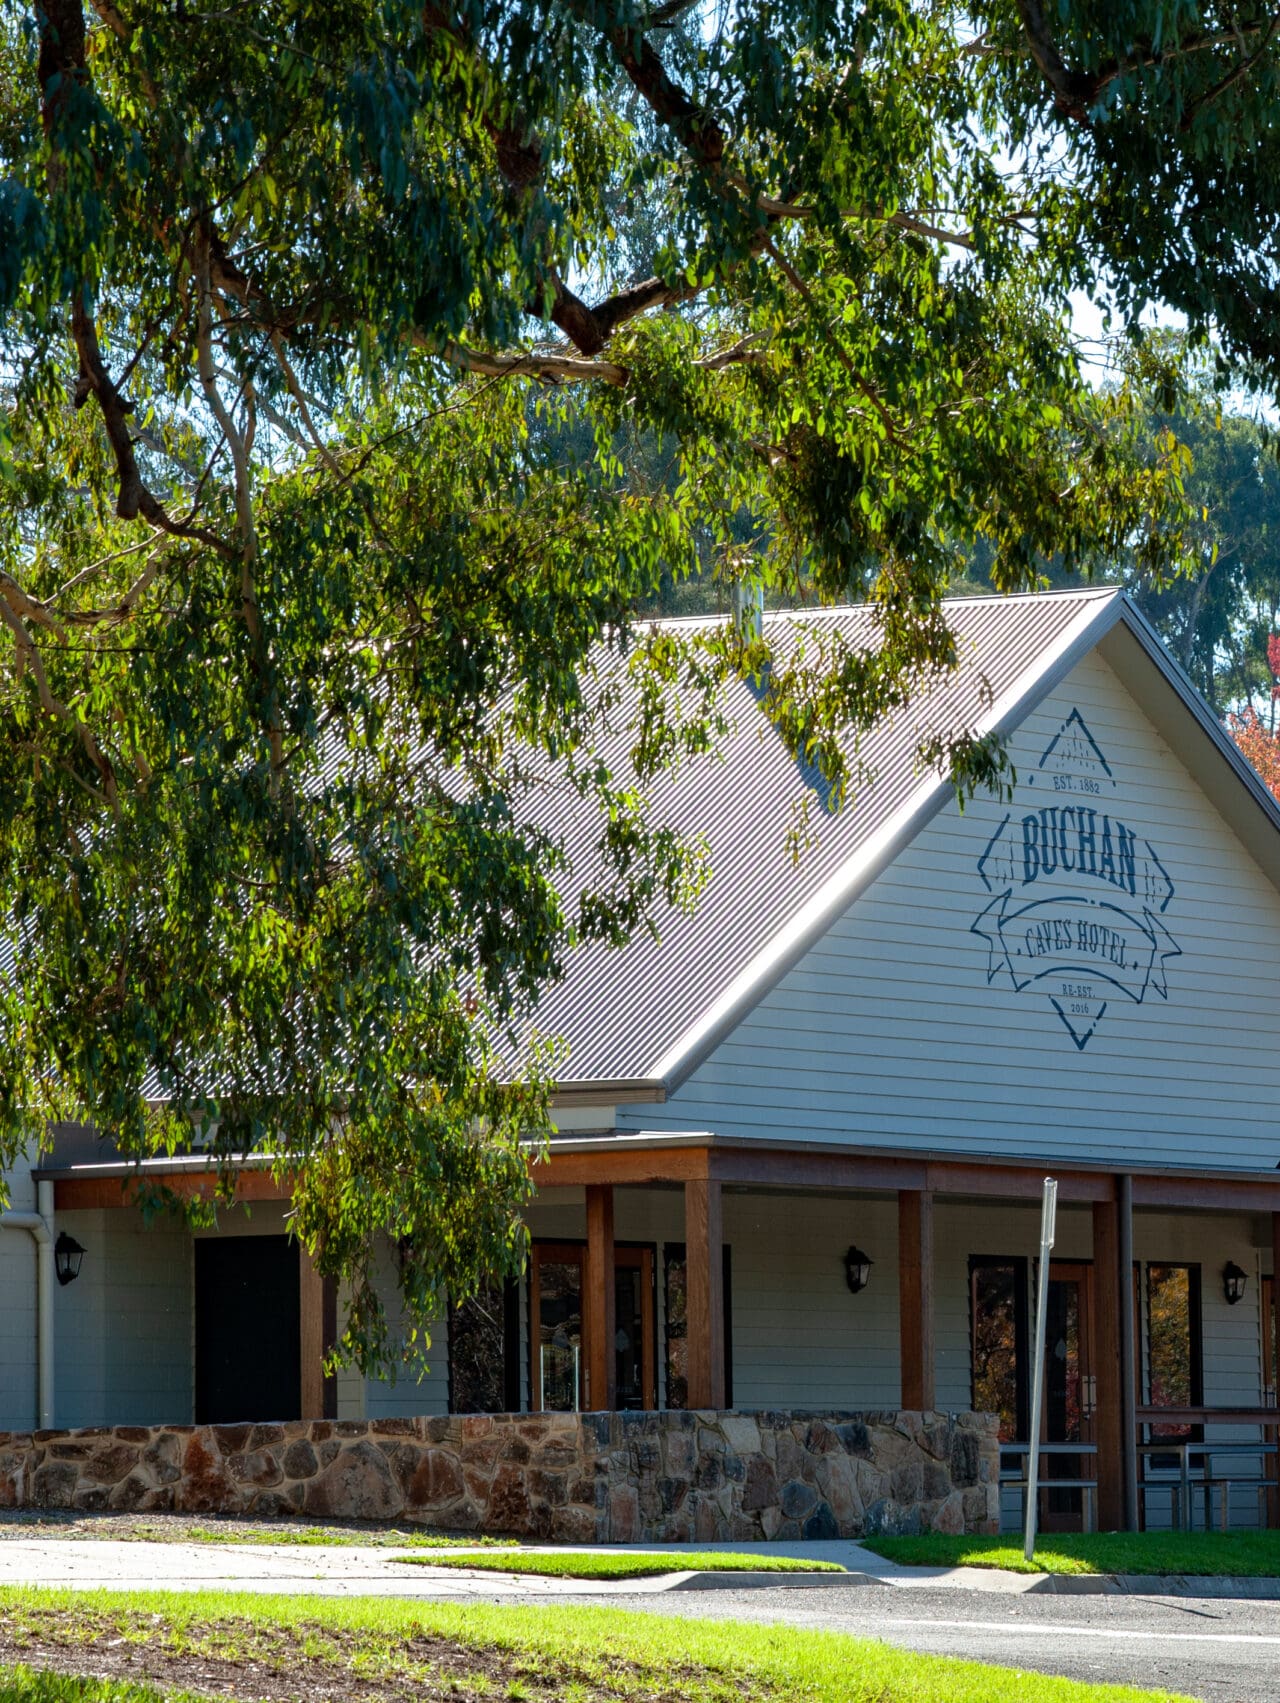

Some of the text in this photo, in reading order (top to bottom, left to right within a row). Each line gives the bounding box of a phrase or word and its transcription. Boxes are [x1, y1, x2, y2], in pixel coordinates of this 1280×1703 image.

[1080, 779, 1100, 794] 1882
[1022, 806, 1137, 898] BUCHAN
[1026, 919, 1128, 970] CAVES HOTEL
[1071, 1003, 1089, 1014] 2016
